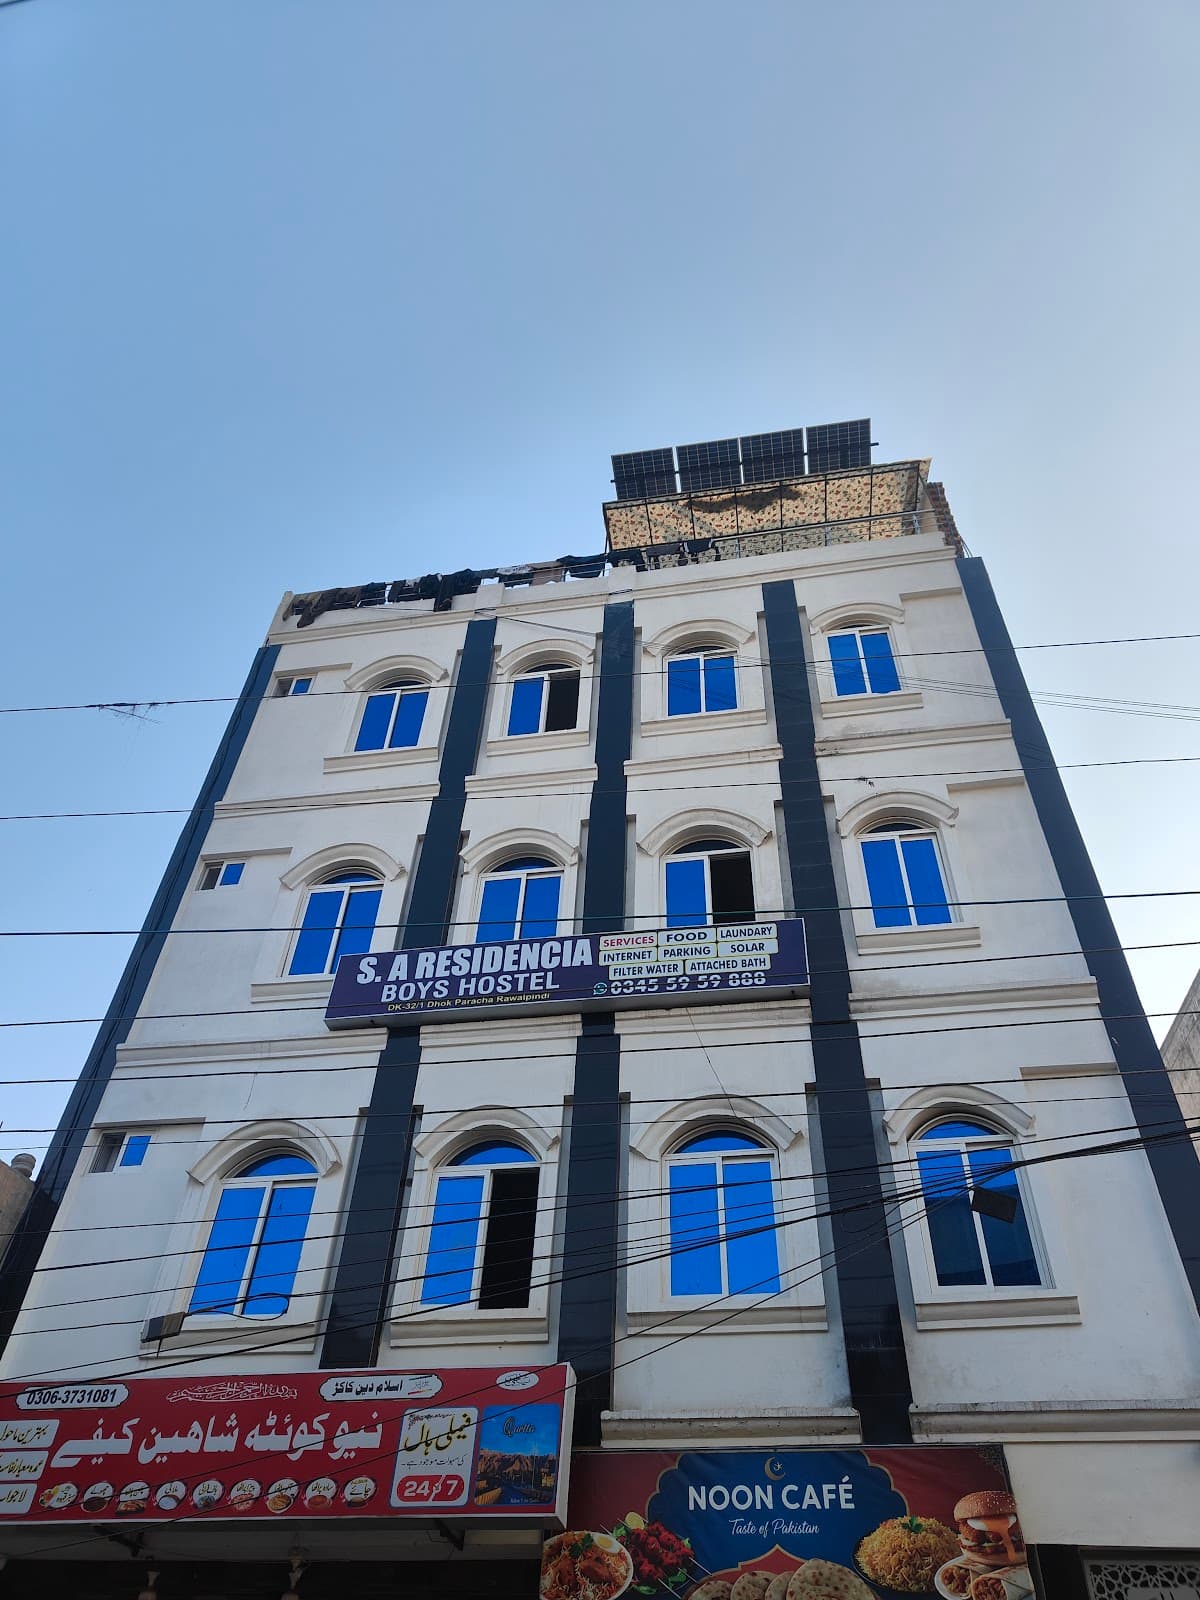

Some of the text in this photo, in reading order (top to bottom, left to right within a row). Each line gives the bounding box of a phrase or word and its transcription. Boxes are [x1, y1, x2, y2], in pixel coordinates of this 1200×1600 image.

[666, 931, 708, 942] FOOD
[720, 927, 773, 939] LAUNDARY
[603, 935, 655, 948] SERVICES
[730, 942, 765, 953] SOLAR
[603, 950, 653, 963] INTERNET
[663, 946, 711, 958] PARKING
[356, 938, 593, 985] S. A RESIDENCIA
[690, 957, 767, 972] ATTACHED BATH
[613, 963, 679, 977] FILTER WATER
[381, 972, 560, 1003] BOYS HOSTEL
[610, 978, 659, 995] 0345
[665, 976, 690, 991] 59
[697, 974, 722, 989] 59
[387, 992, 550, 1012] DK-32/1 Dhok Paracha Rawalpindi
[375, 1379, 403, 1395] اسلام
[26, 1388, 118, 1405] 0306-3731081
[49, 1409, 384, 1468] نیو کوئٹہ شاہین کیفے
[688, 1476, 856, 1511] NOON CAFÉ
[729, 1518, 820, 1538] Taste of Pakistan
